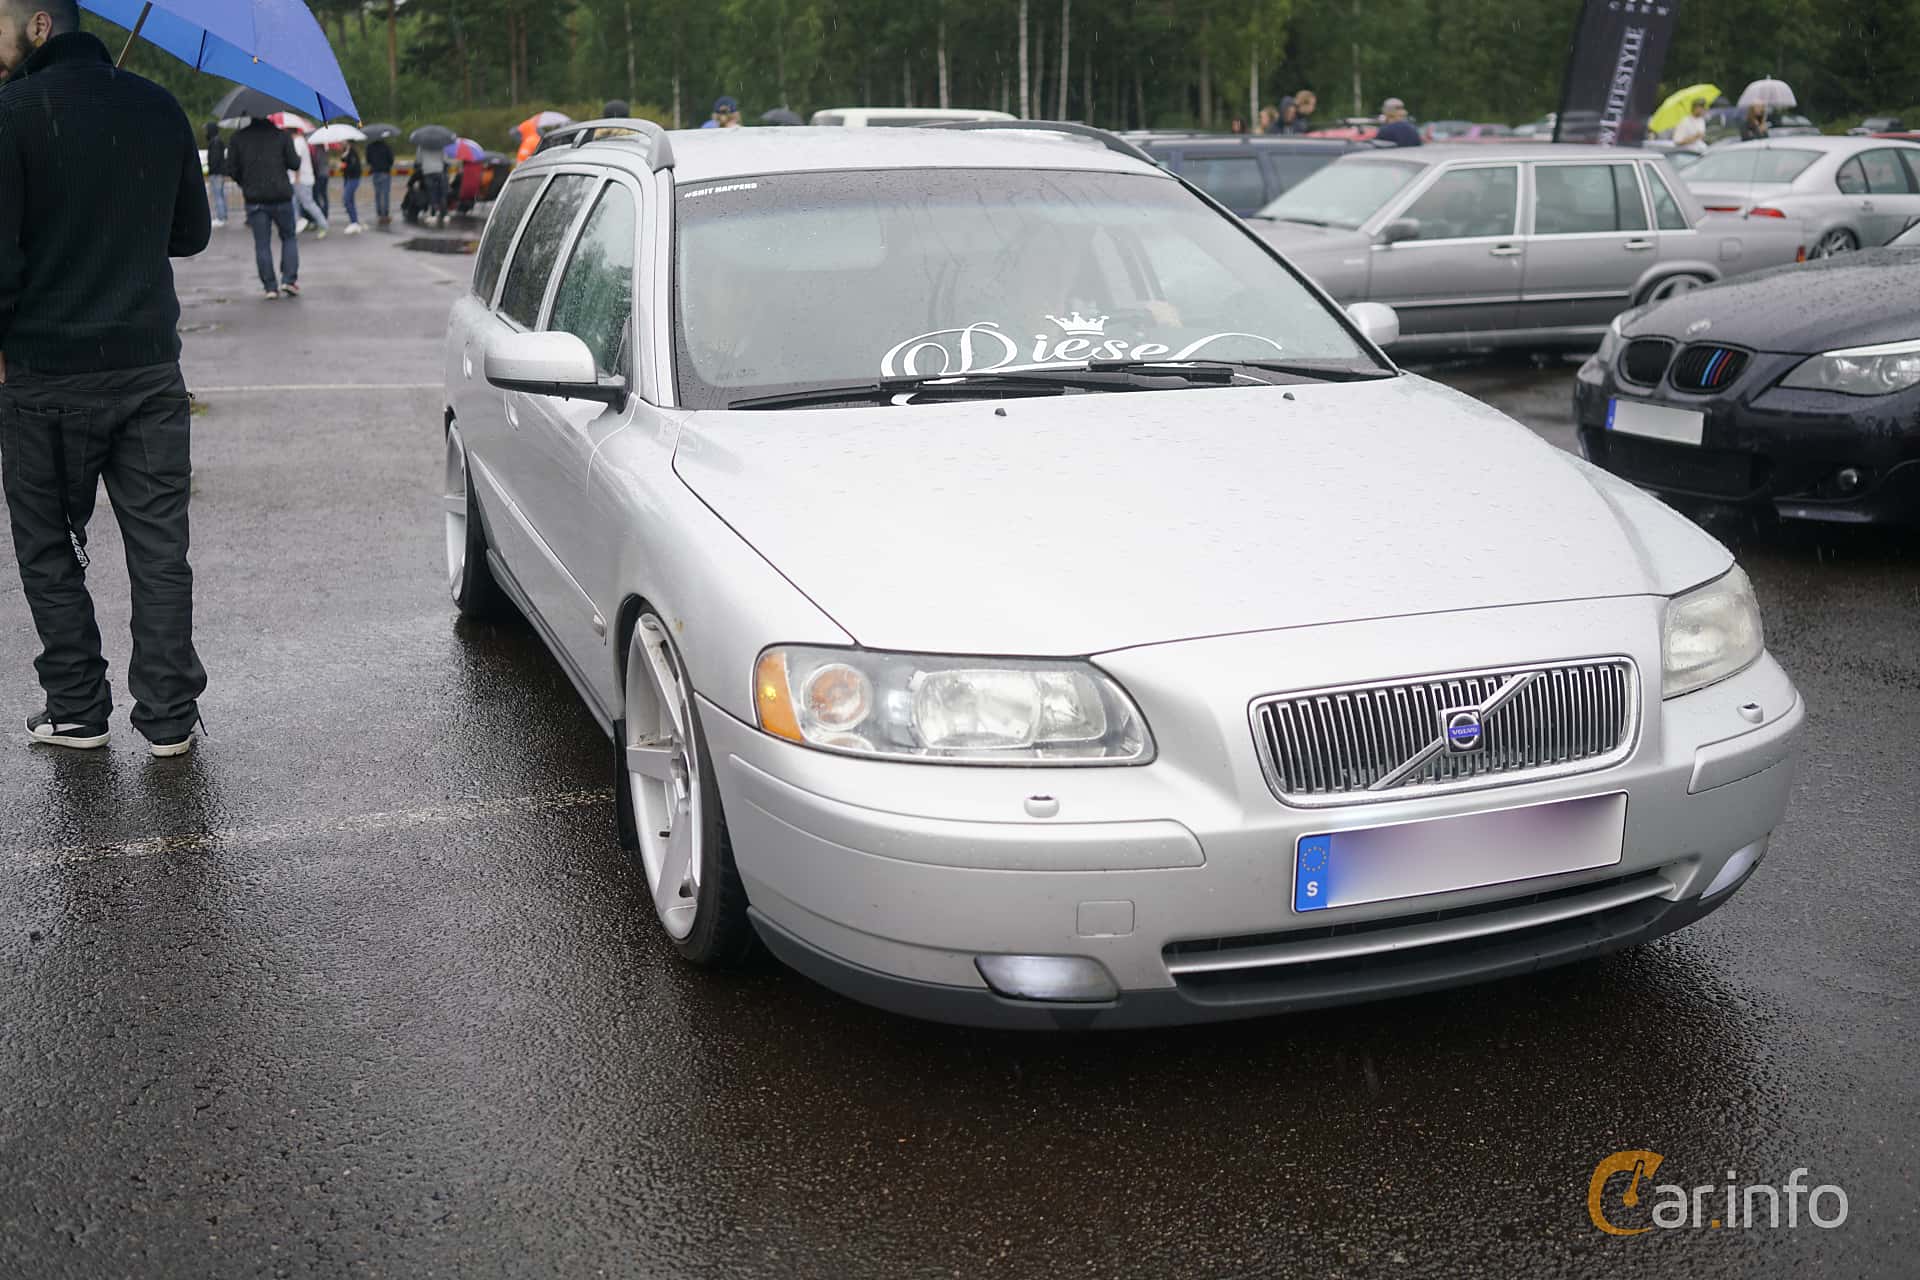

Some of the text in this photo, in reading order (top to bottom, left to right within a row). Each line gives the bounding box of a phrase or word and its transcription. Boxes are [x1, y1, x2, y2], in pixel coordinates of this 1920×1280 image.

[880, 321, 1283, 380] Diesel
[1451, 727, 1478, 736] VOLVO
[1306, 880, 1319, 897] S
